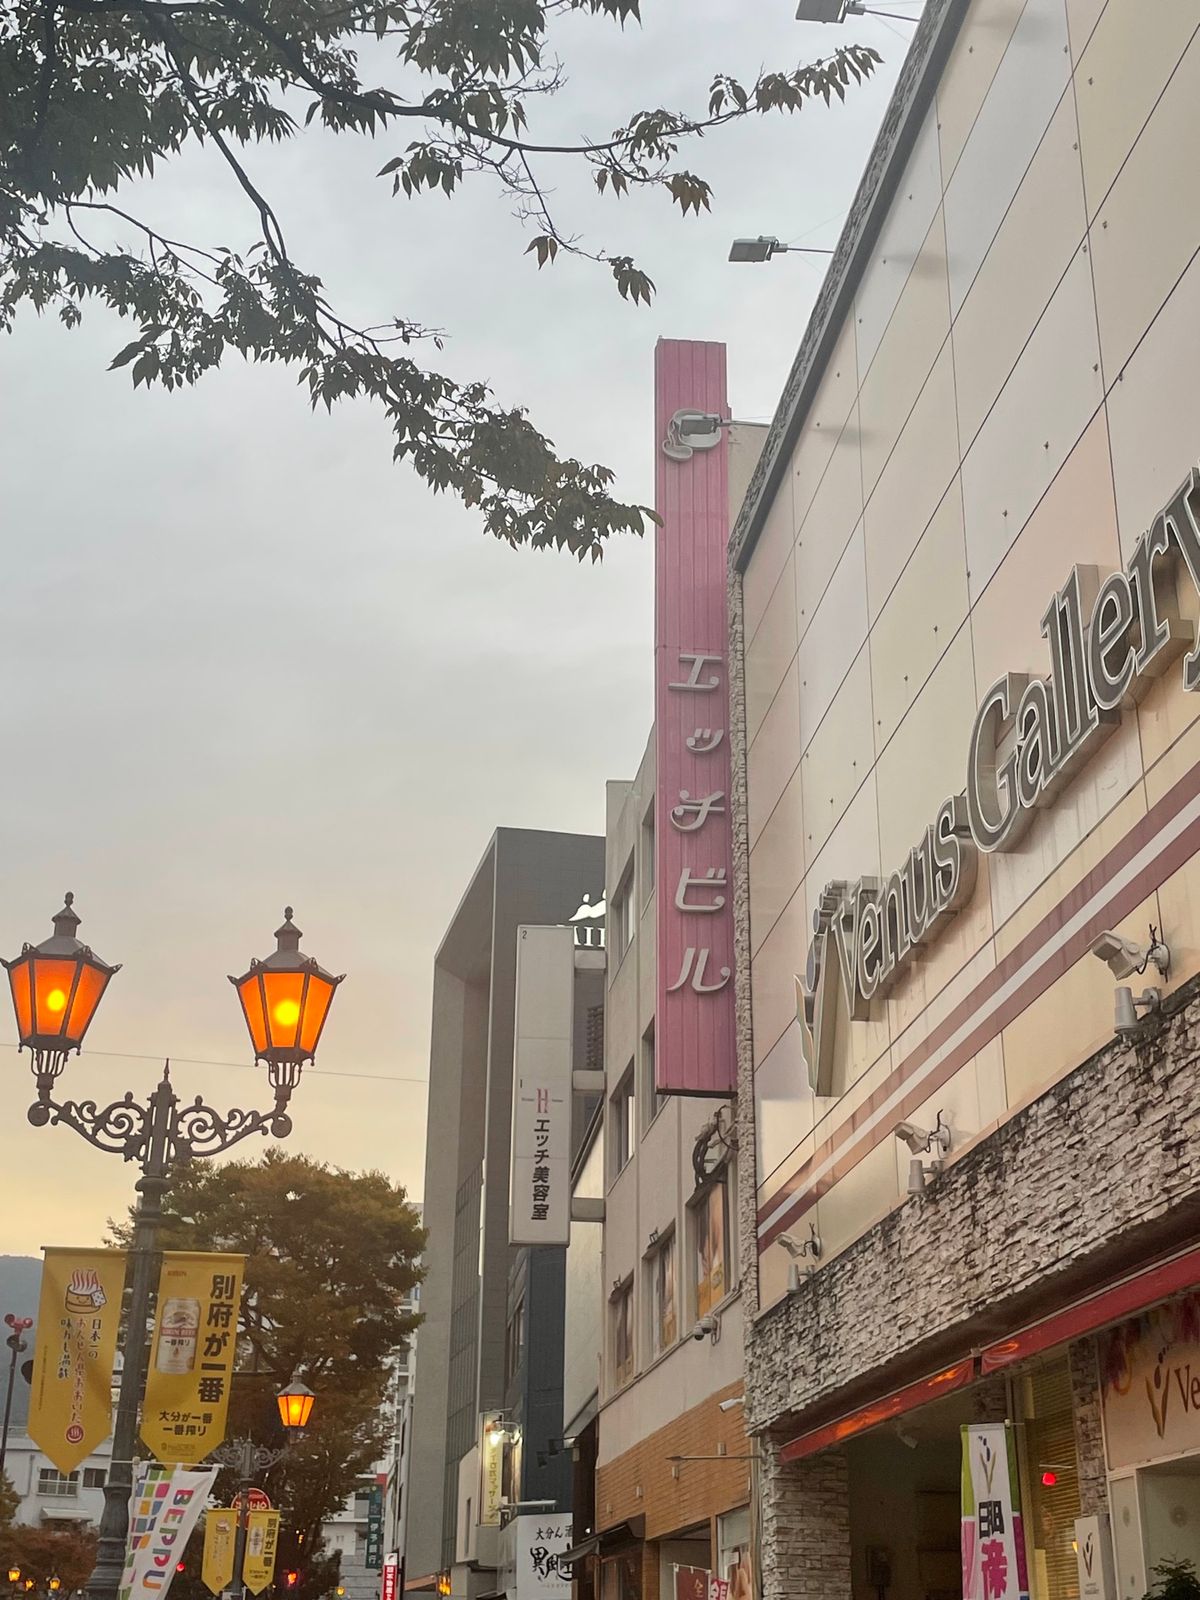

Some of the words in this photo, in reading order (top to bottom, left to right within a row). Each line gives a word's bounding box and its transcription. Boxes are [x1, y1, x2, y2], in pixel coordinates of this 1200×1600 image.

[666, 653, 731, 994] エッチビル
[831, 796, 961, 1020] Venus
[531, 1118, 551, 1220] エッチ美容室
[88, 1318, 102, 1360] 日本一の
[198, 1274, 236, 1403] 別府が一番
[159, 1410, 213, 1424] 大分が一番
[142, 1489, 195, 1590] BEPPU
